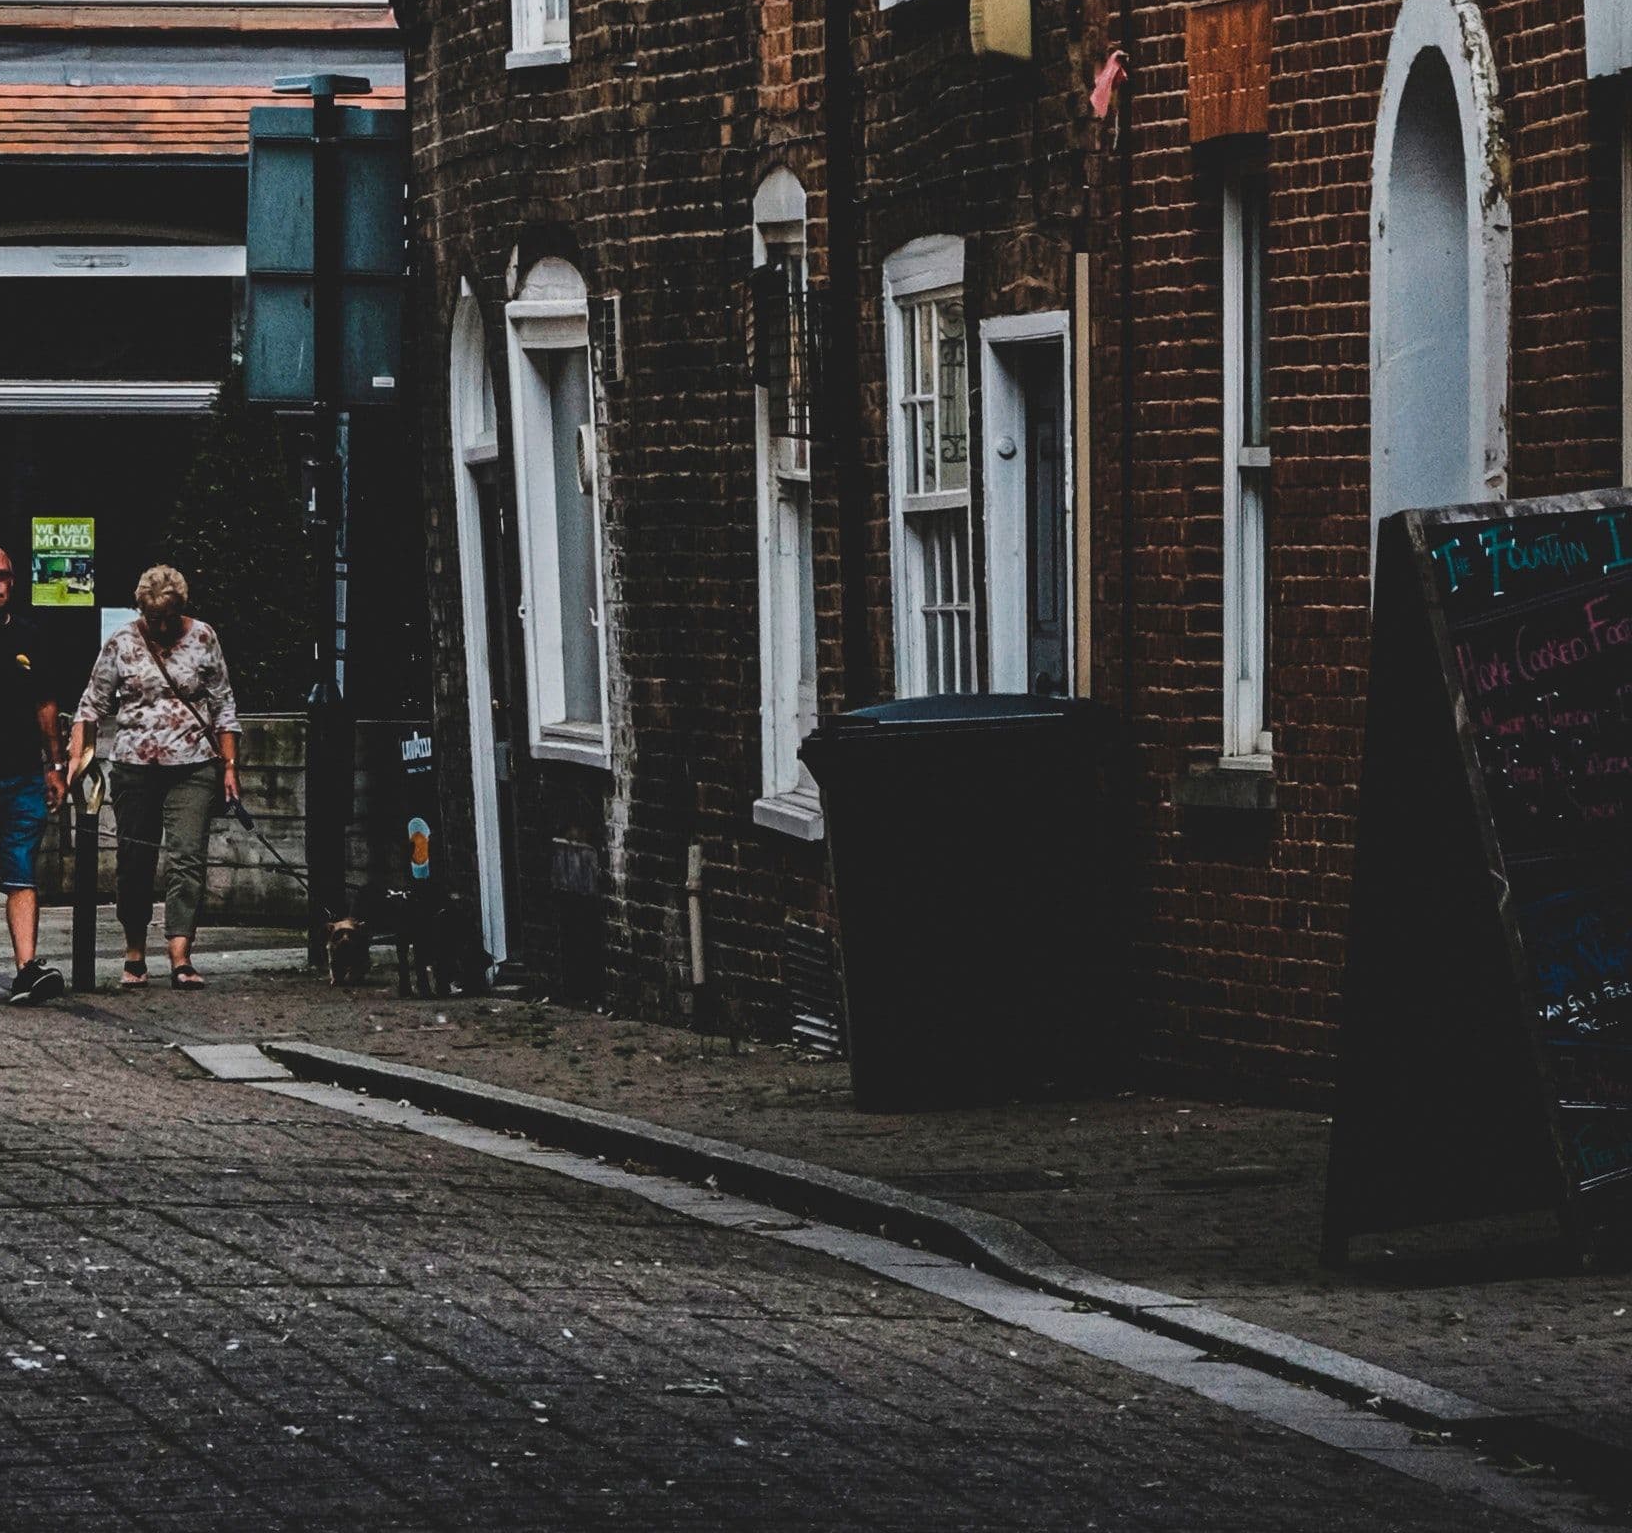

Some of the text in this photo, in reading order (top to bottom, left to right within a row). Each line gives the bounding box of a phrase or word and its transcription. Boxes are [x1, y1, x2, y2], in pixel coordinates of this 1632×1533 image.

[35, 523, 91, 535] WE HAVE
[35, 534, 91, 548] MOVED
[1593, 512, 1632, 575] I
